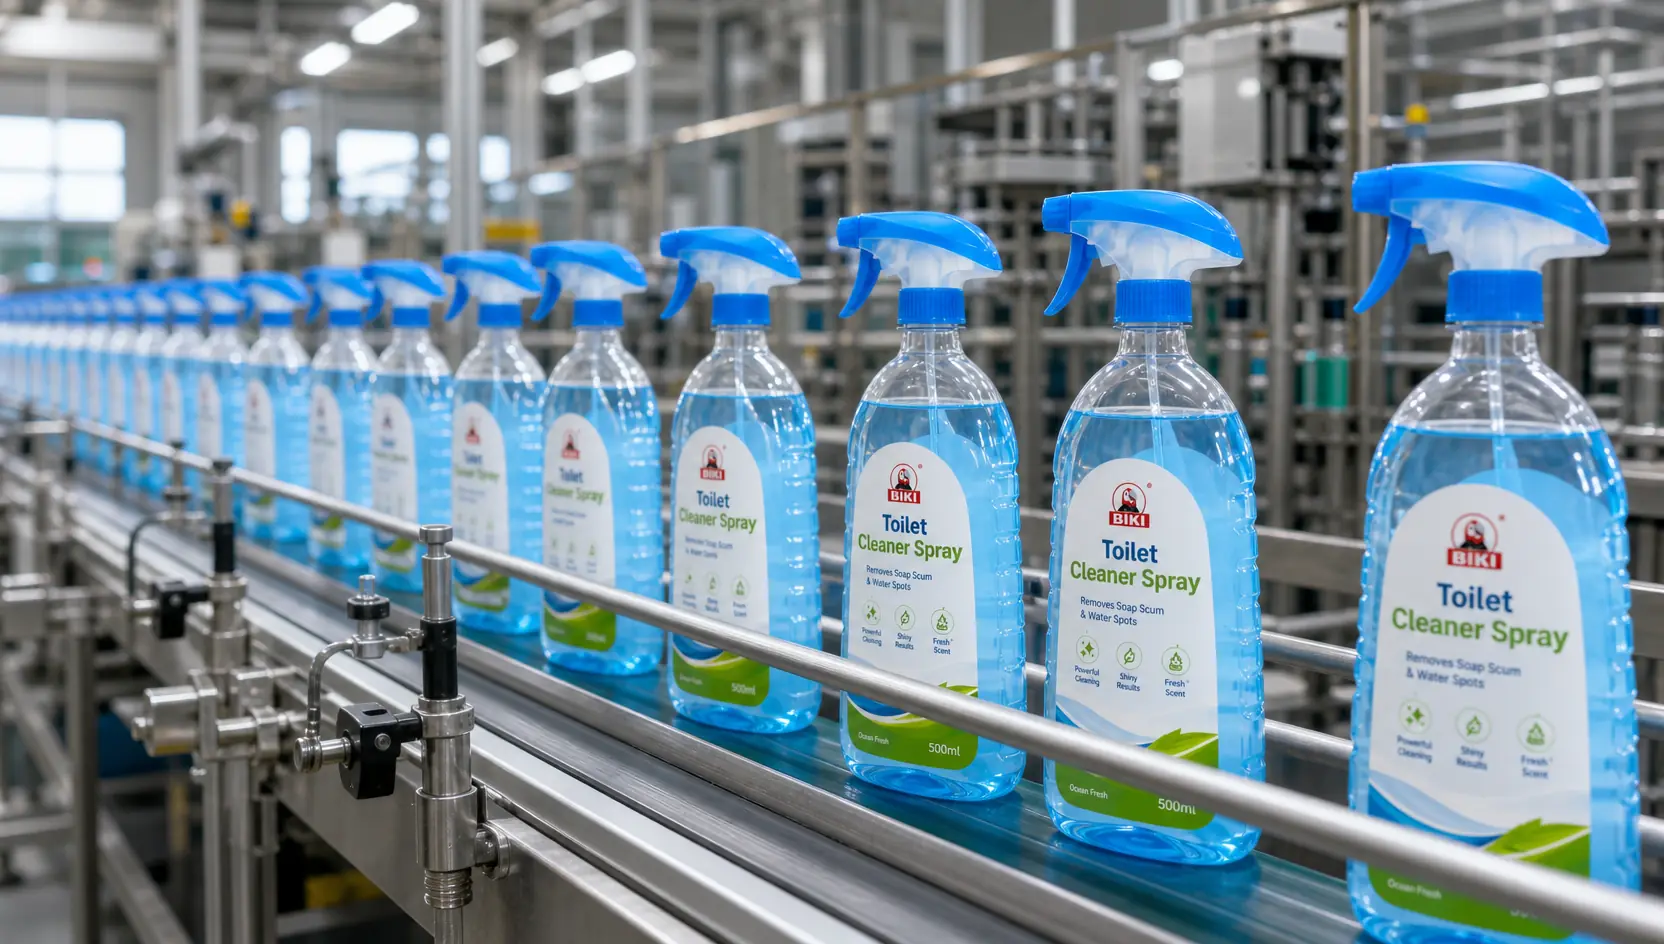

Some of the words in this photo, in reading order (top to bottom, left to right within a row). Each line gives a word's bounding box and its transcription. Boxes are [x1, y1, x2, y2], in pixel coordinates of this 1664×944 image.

[696, 490, 730, 508] Toilet
[890, 490, 917, 502] BIKI
[679, 507, 716, 526] Cleaner
[720, 513, 756, 534] Spray
[882, 514, 927, 535] Toilet
[1112, 513, 1145, 527] BIKI
[858, 534, 910, 555] Cleaner
[914, 540, 962, 564] Spray
[1102, 539, 1158, 563] Toilet
[1452, 550, 1498, 568] BIKI
[866, 565, 893, 576] Removes
[894, 570, 910, 580] Soap
[912, 572, 932, 580] Scum
[1070, 560, 1136, 586] Cleaner
[1142, 569, 1201, 596] Spray
[872, 578, 890, 588] Water
[892, 582, 911, 591] Spots
[1437, 582, 1513, 612] Toilet
[1080, 596, 1115, 610] Removes
[1116, 602, 1137, 614] Soap
[1140, 605, 1164, 616] Scum
[1080, 610, 1086, 619] &
[1088, 611, 1111, 622] Water
[1114, 615, 1138, 626] Spots
[1392, 608, 1484, 640] Cleaner
[1492, 620, 1568, 654] Spray
[895, 642, 914, 650] Results
[1074, 665, 1100, 676] Powerful
[1406, 651, 1453, 668] Removes
[1456, 659, 1484, 674] Soap
[1488, 663, 1522, 676] Scum
[1120, 672, 1138, 683] Shiny
[1164, 678, 1186, 688] Fresh
[1406, 668, 1413, 678] &
[1417, 669, 1448, 684] Water
[1452, 674, 1484, 688] Spots
[732, 683, 756, 696] 500ml
[1116, 682, 1140, 692] Results
[1166, 688, 1186, 698] Scent
[928, 742, 960, 756] 500ml
[1397, 735, 1432, 750] Powerful
[1460, 746, 1484, 759] Shiny
[1456, 757, 1488, 772] Results
[1520, 755, 1548, 766] Fresh
[1522, 768, 1548, 780] Scent
[1070, 784, 1088, 795] Ocean
[1090, 788, 1108, 800] Fresh
[1158, 798, 1196, 815] 500ml
